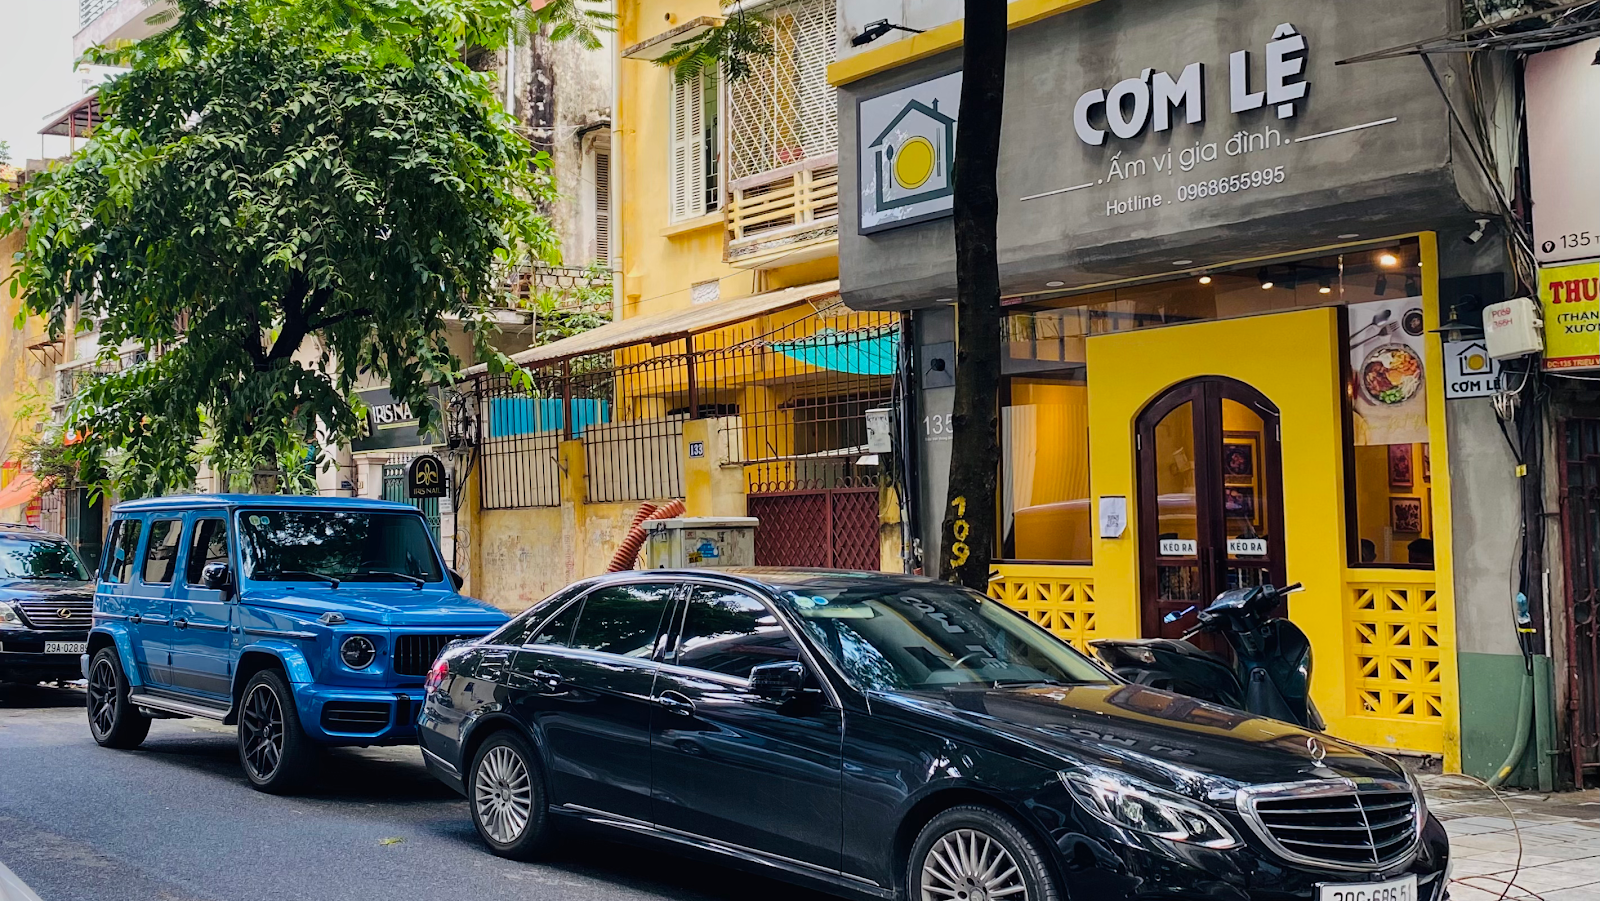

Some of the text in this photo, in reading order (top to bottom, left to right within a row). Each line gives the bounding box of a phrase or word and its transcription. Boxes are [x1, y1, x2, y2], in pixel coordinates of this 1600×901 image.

[1073, 22, 1308, 146] CƠM LỆ
[1152, 147, 1172, 175] vị
[1179, 141, 1218, 172] gia
[1106, 194, 1162, 217] Hotline
[1177, 165, 1285, 202] 0968655995
[1560, 231, 1591, 249] 135
[1451, 379, 1481, 393] CƠM
[372, 403, 394, 424] IRIS
[922, 413, 953, 436] 135
[690, 443, 704, 456] 133
[413, 487, 442, 496] IRIS NAIL
[1182, 543, 1194, 552] RA
[1250, 542, 1263, 552] RA
